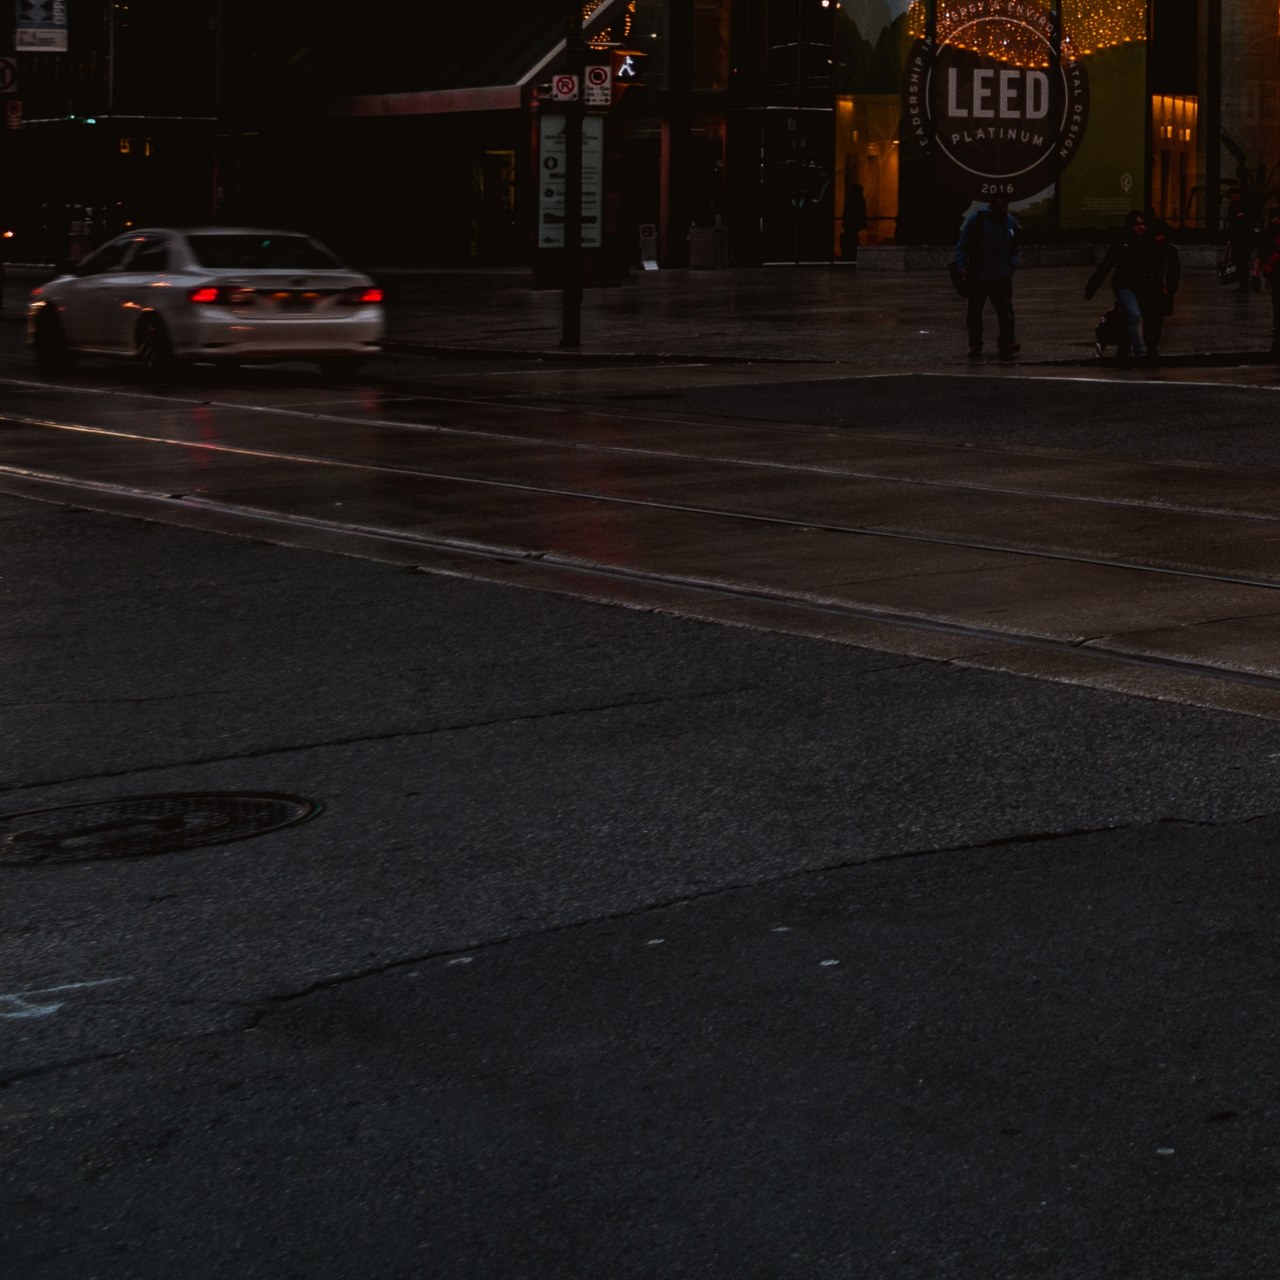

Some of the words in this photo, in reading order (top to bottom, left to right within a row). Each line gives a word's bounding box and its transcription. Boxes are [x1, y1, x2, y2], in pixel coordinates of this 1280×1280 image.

[948, 67, 1050, 120] LEED
[951, 127, 1044, 148] PLATINUM
[1059, 104, 1083, 158] DESIGN
[981, 183, 1014, 195] 2016
